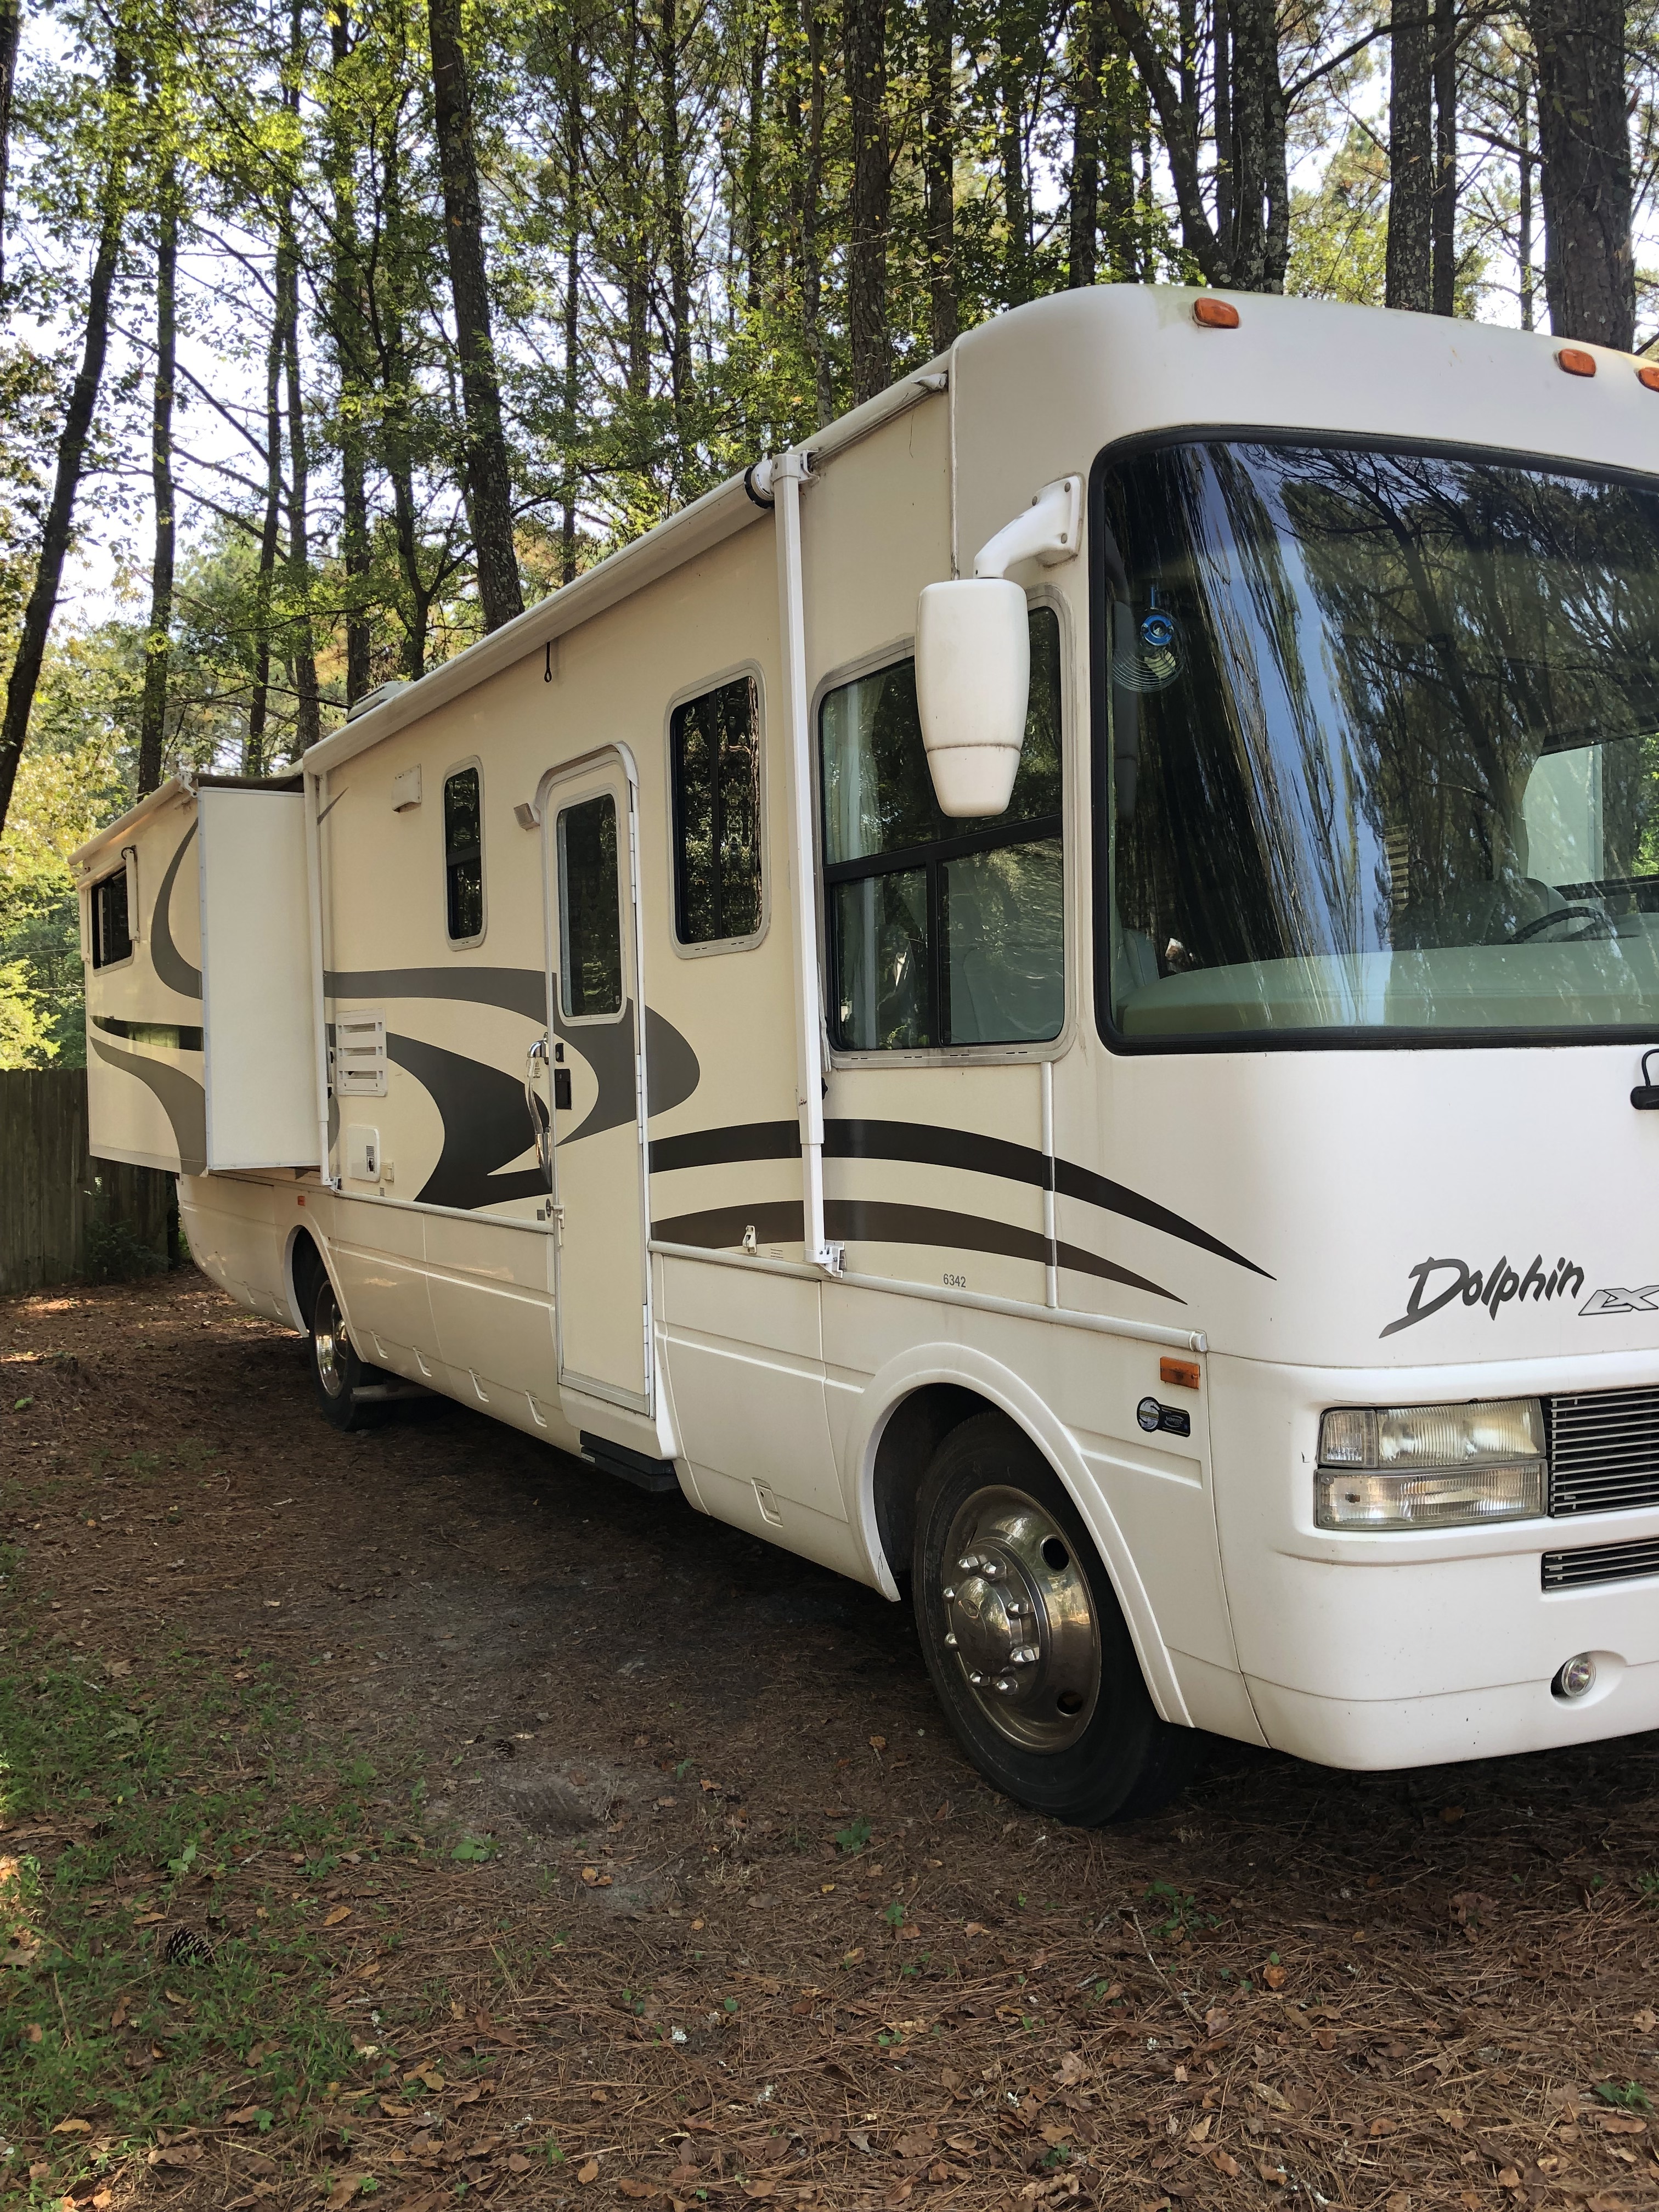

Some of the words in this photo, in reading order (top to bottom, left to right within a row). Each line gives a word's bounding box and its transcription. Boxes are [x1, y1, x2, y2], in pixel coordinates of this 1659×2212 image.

[943, 1273, 966, 1288] 6342
[1378, 1254, 1585, 1339] Dolphin
[1578, 1284, 1659, 1316] LX
